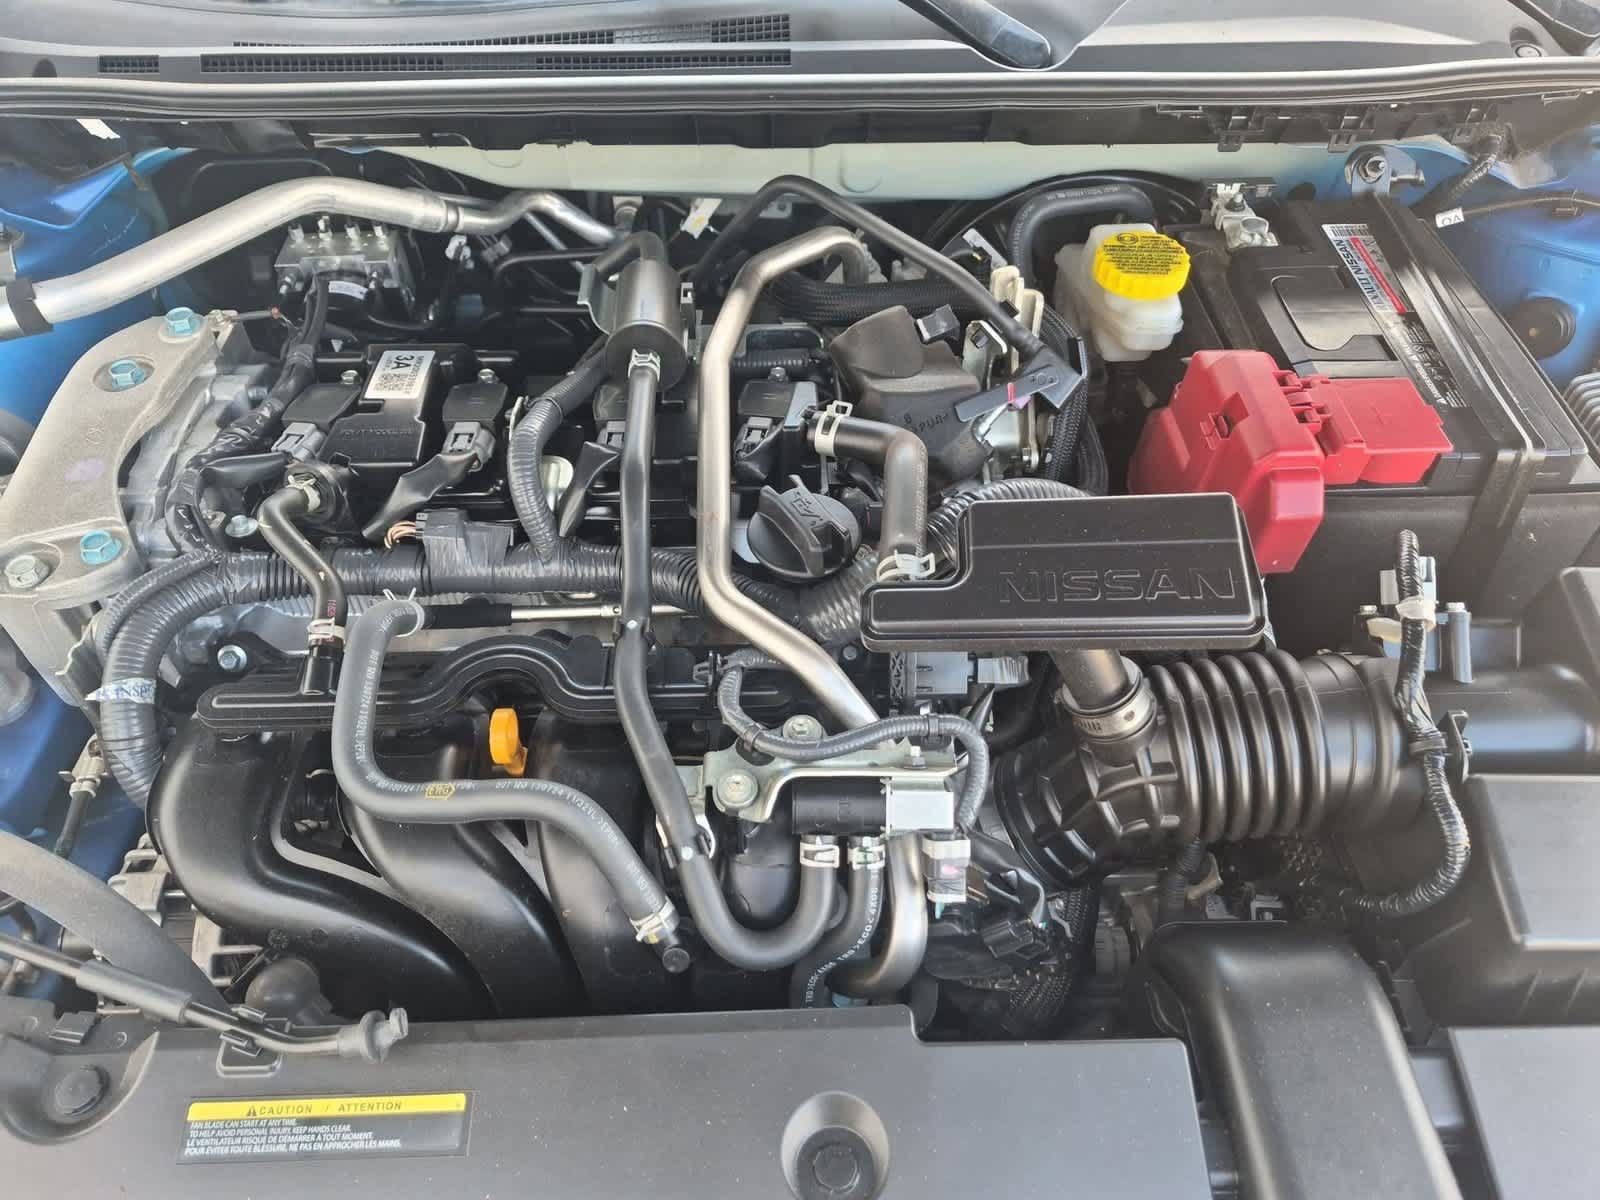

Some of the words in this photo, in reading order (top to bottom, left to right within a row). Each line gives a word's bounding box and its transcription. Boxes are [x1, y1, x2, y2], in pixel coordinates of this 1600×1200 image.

[1333, 239, 1364, 275] NISSAN
[391, 355, 415, 369] 3A
[999, 568, 1235, 602] NISSAN
[259, 1104, 313, 1116] CAUTION
[338, 1101, 402, 1113] ATTENTION
[198, 1129, 215, 1137] HELP
[236, 1128, 267, 1136] PERSONAL
[292, 1126, 307, 1134] KEEP
[307, 1125, 329, 1133] HANDS
[186, 1138, 195, 1146] LE
[196, 1137, 240, 1146] VENTILATEUR
[241, 1136, 266, 1144] RISQUE
[184, 1147, 204, 1155] POUR
[288, 1143, 297, 1151] NE
[299, 1143, 312, 1151] PAS
